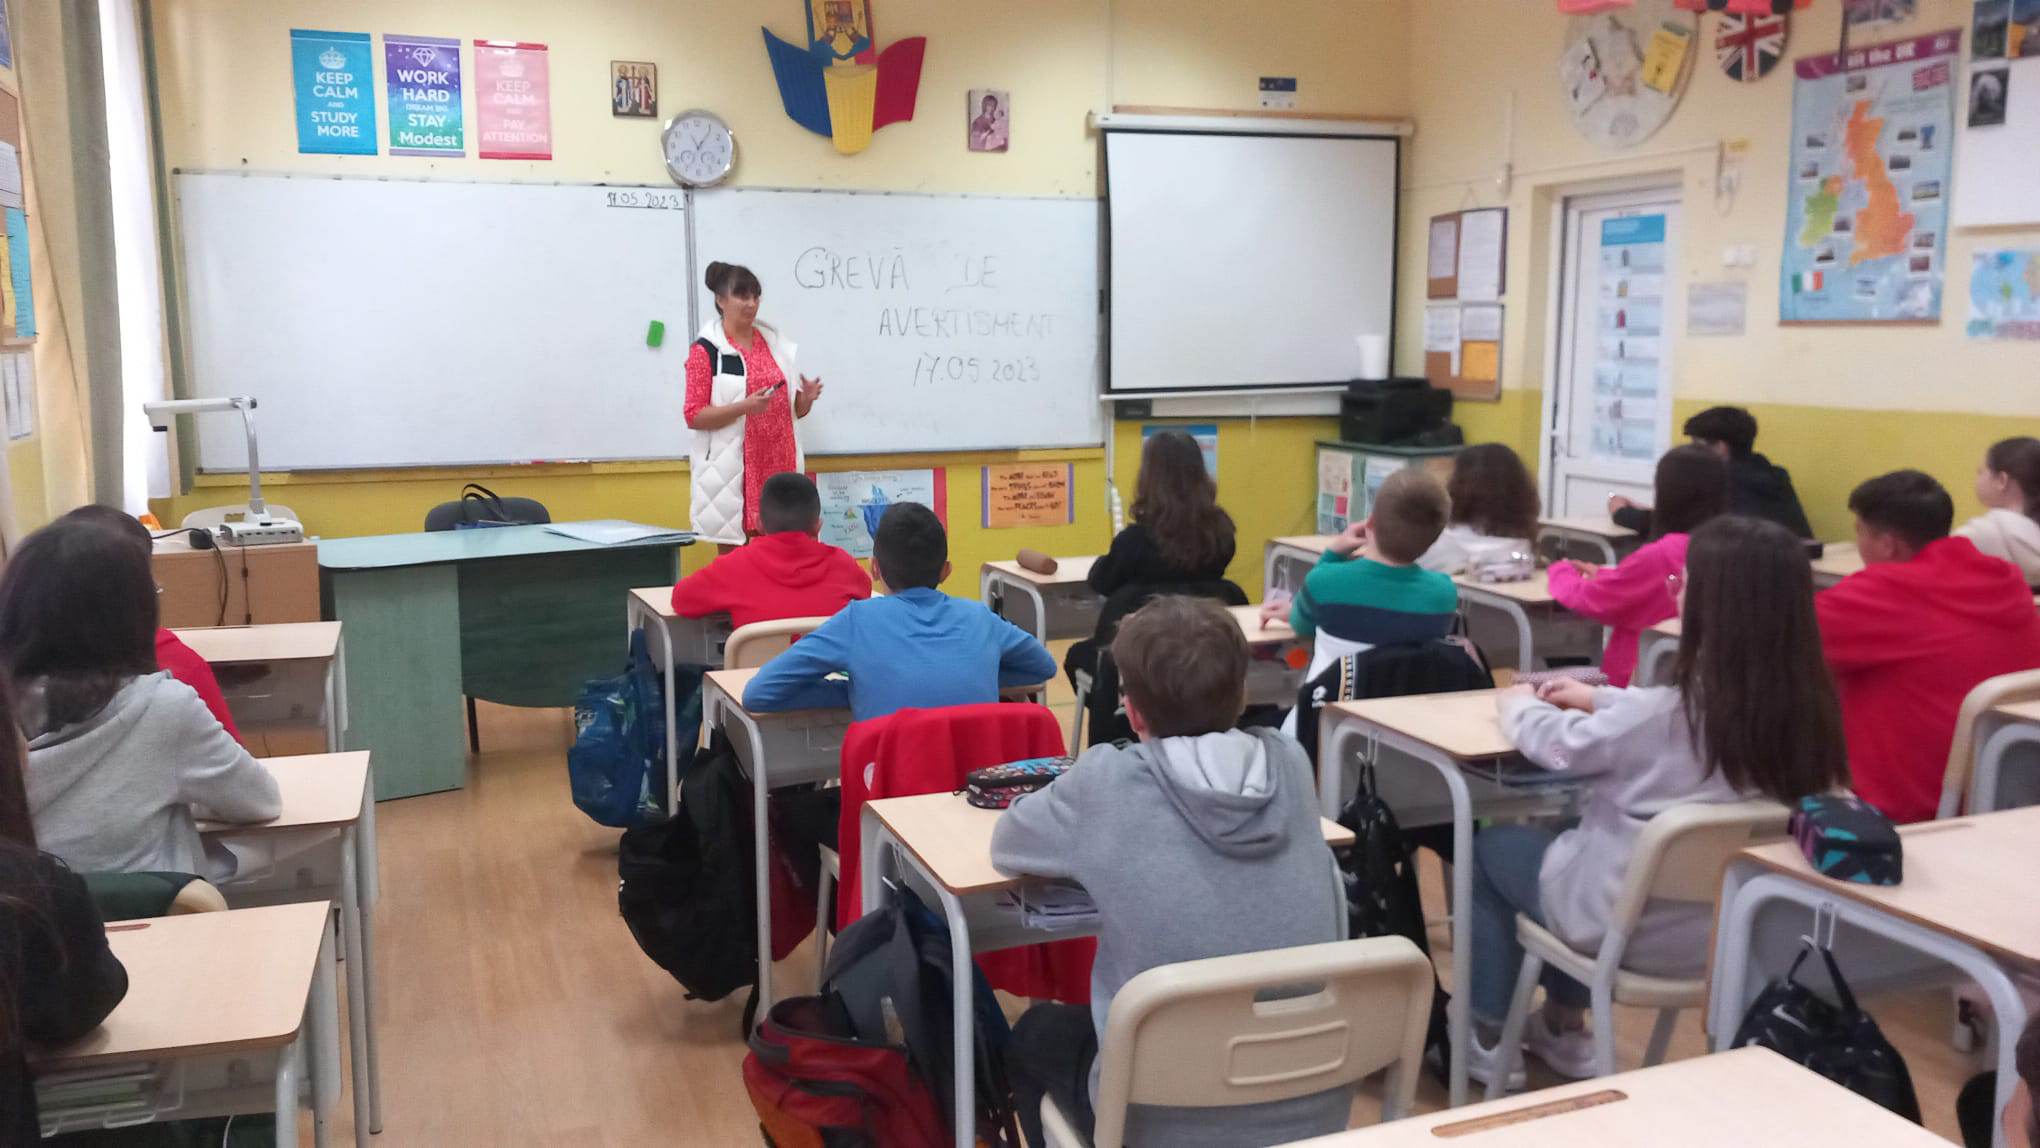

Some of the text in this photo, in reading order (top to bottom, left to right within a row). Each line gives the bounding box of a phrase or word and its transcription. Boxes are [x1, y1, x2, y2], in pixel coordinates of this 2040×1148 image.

[315, 71, 353, 85] KEEP
[397, 69, 449, 86] WORK
[312, 84, 358, 99] CALM
[496, 79, 531, 93] KEEP
[403, 87, 450, 102] HARD
[493, 92, 536, 106] CALM
[311, 110, 358, 124] STUDY
[408, 113, 446, 128] STAY
[317, 125, 359, 138] MORE
[504, 119, 526, 130] PAY
[399, 131, 457, 146] Modest
[482, 130, 548, 144] ATTENTION
